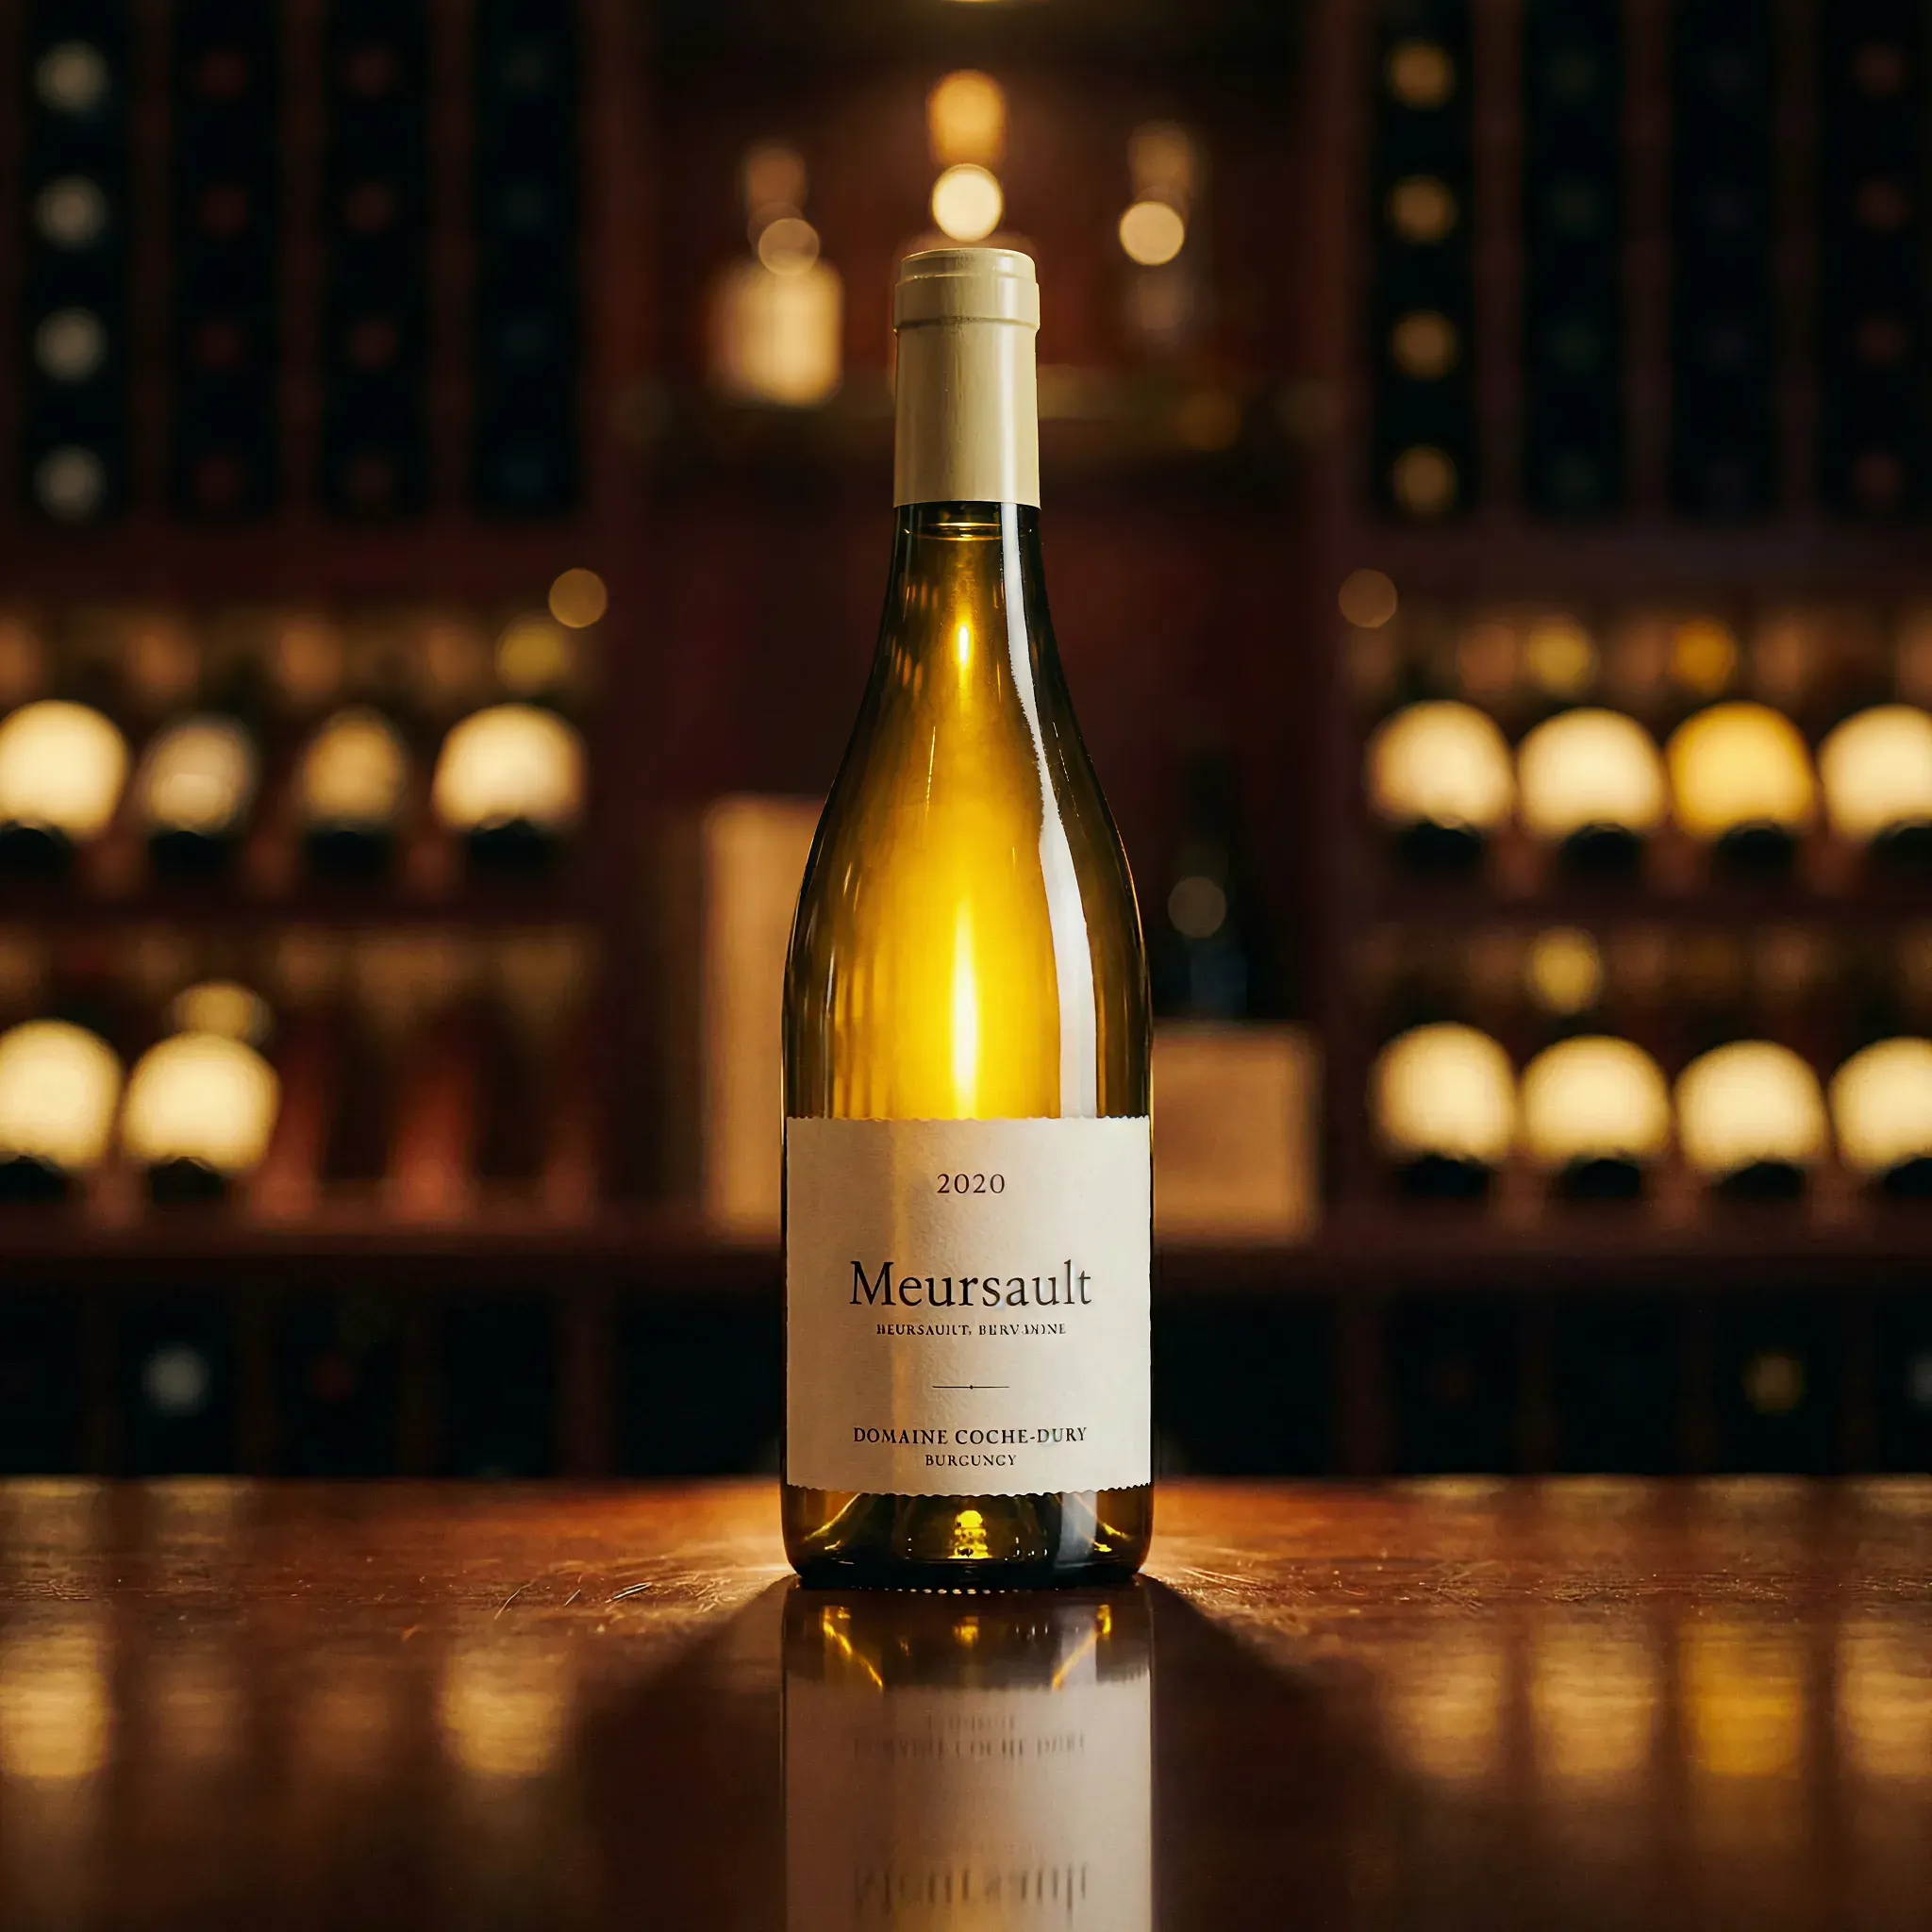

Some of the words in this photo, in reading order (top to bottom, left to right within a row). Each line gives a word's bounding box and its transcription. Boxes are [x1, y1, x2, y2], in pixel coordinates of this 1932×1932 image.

[937, 1174, 1006, 1194] 2020
[849, 1258, 1092, 1307] Meursault
[853, 1427, 948, 1444] DOMAINE
[955, 1426, 1087, 1444] COCHE-DURY
